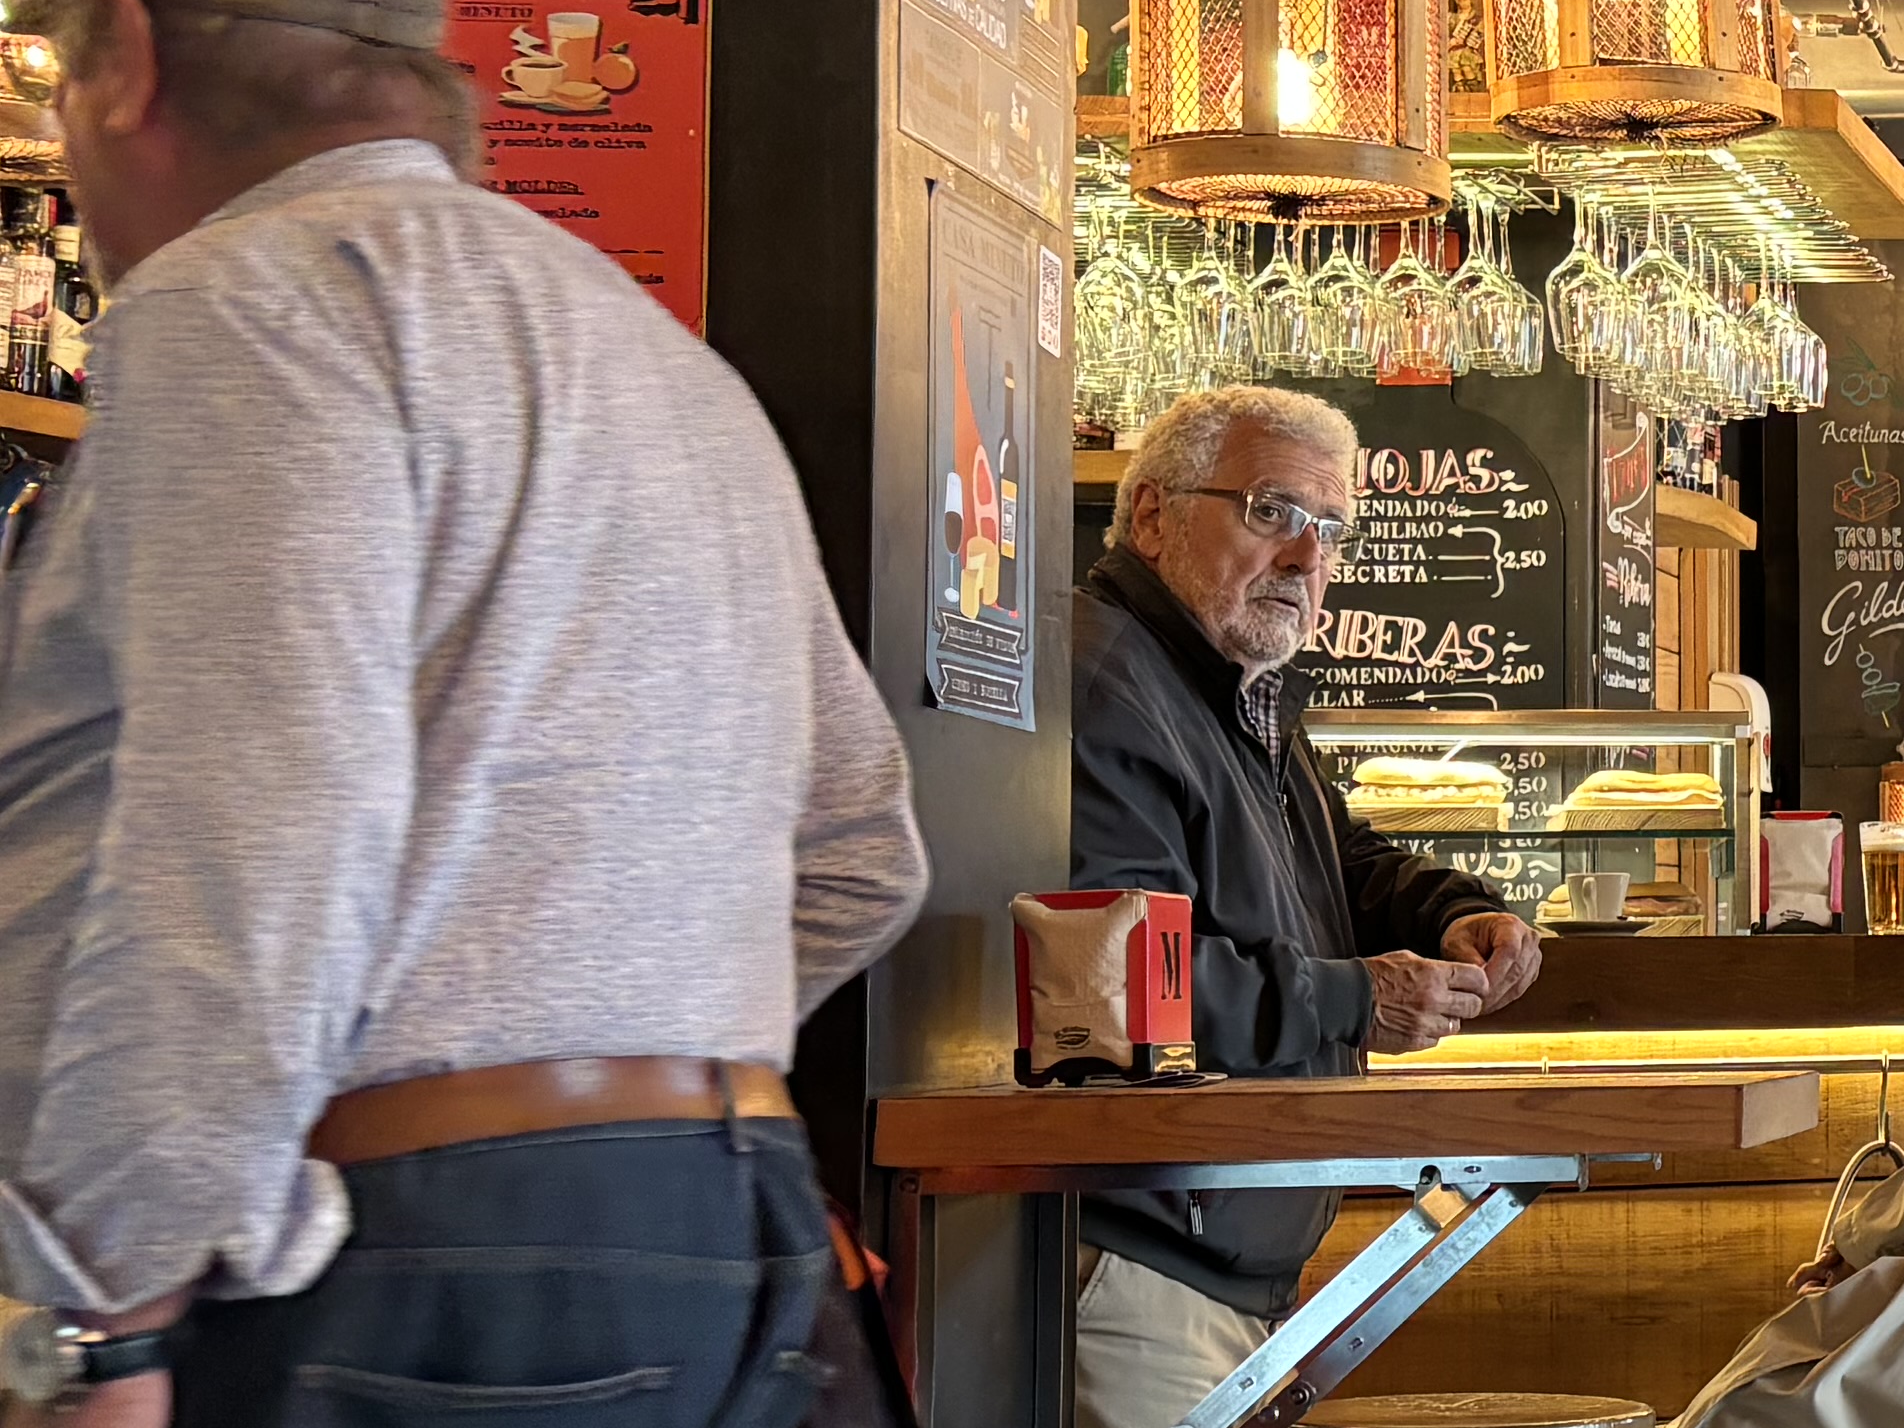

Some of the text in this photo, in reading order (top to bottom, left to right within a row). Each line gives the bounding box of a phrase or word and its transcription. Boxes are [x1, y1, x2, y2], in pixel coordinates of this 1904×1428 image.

[1352, 448, 1501, 497] IOJAS
[1370, 521, 1443, 539] BILBAO
[1833, 526, 1903, 549] TACO DE
[1833, 548, 1904, 572] BONITO
[1302, 609, 1495, 671] RIBERAS
[1160, 931, 1182, 1000] M
